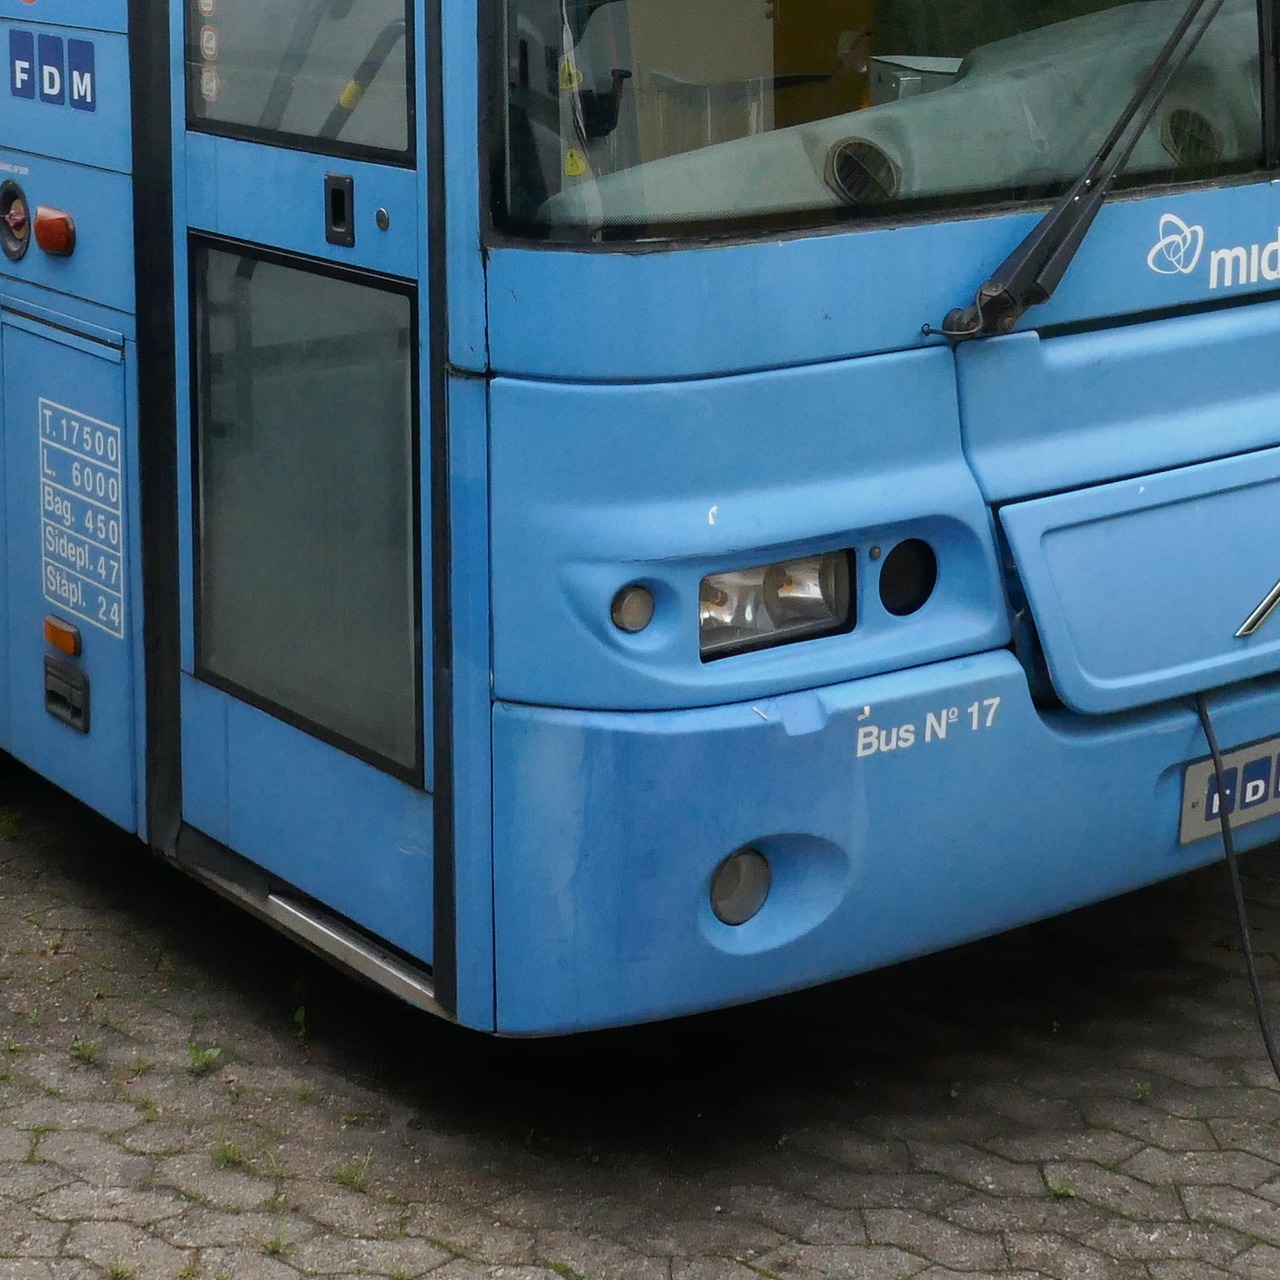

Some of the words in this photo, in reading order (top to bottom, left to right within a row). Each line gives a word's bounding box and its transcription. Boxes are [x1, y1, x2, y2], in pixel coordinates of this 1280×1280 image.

[15, 60, 92, 103] FDM
[72, 461, 118, 503] 6000
[44, 486, 75, 527] Bag.
[85, 509, 118, 545] 450
[97, 595, 120, 627] 24
[856, 723, 915, 757] Bus
[967, 696, 1001, 731] 17
